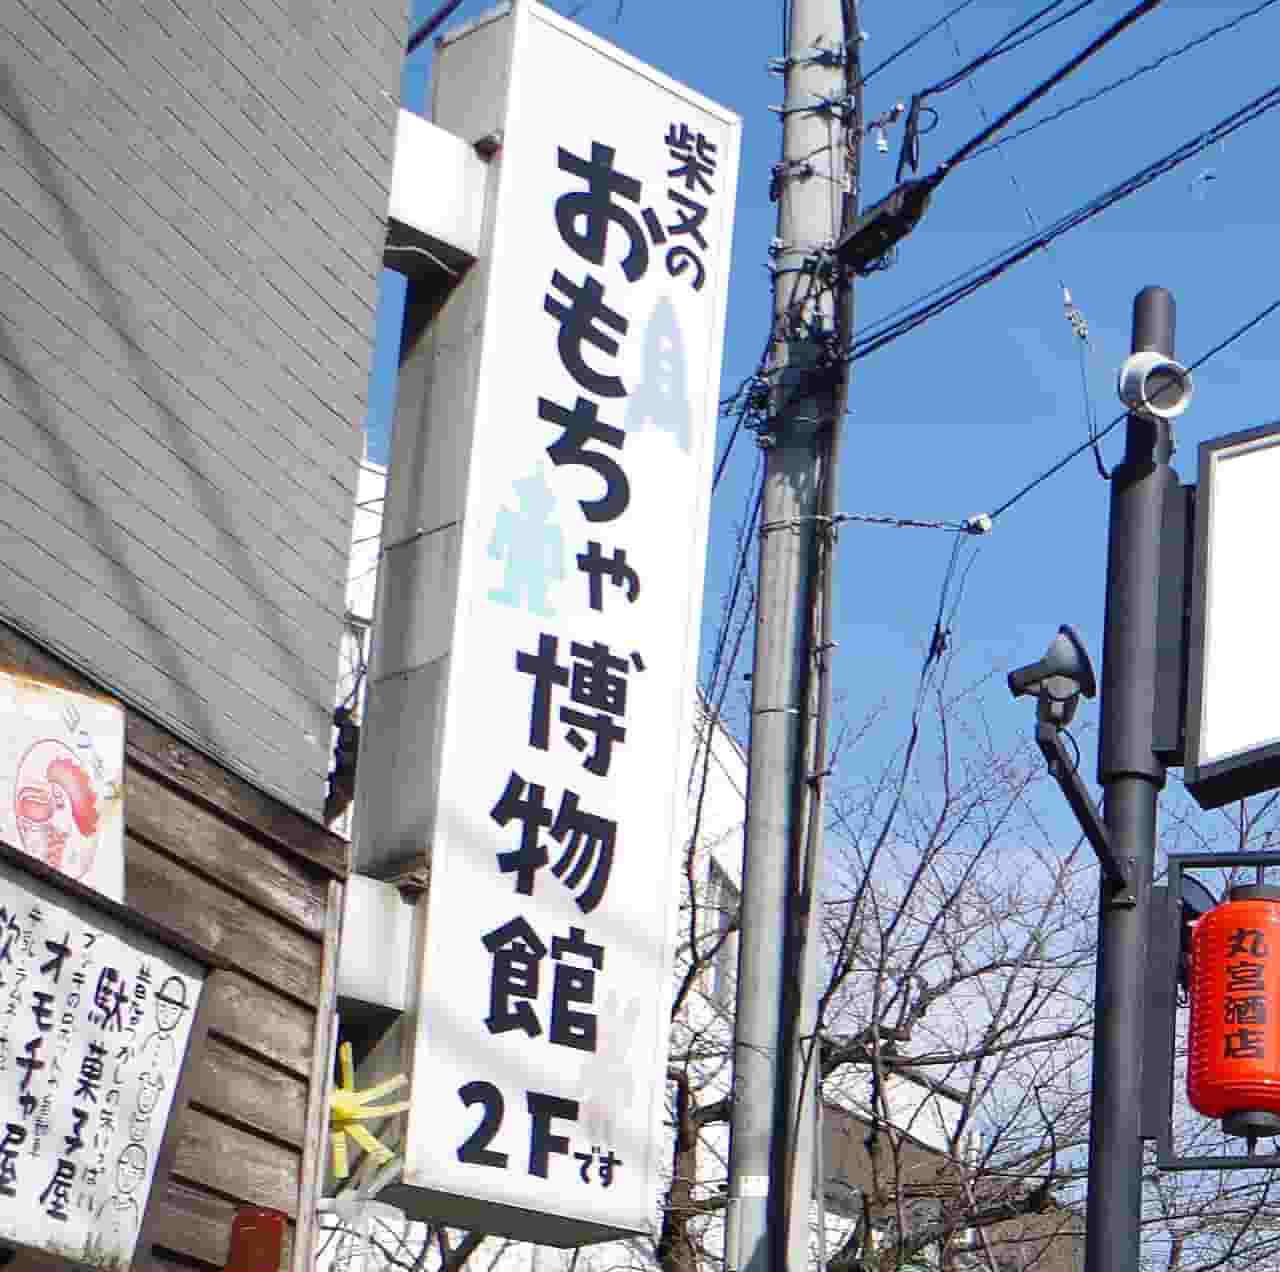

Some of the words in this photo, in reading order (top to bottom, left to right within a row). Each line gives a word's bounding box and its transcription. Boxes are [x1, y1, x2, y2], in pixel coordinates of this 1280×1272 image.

[664, 122, 717, 292] 柴又の
[481, 140, 665, 1052] おもちゃ博物館
[457, 1080, 622, 1189] 2Fです
